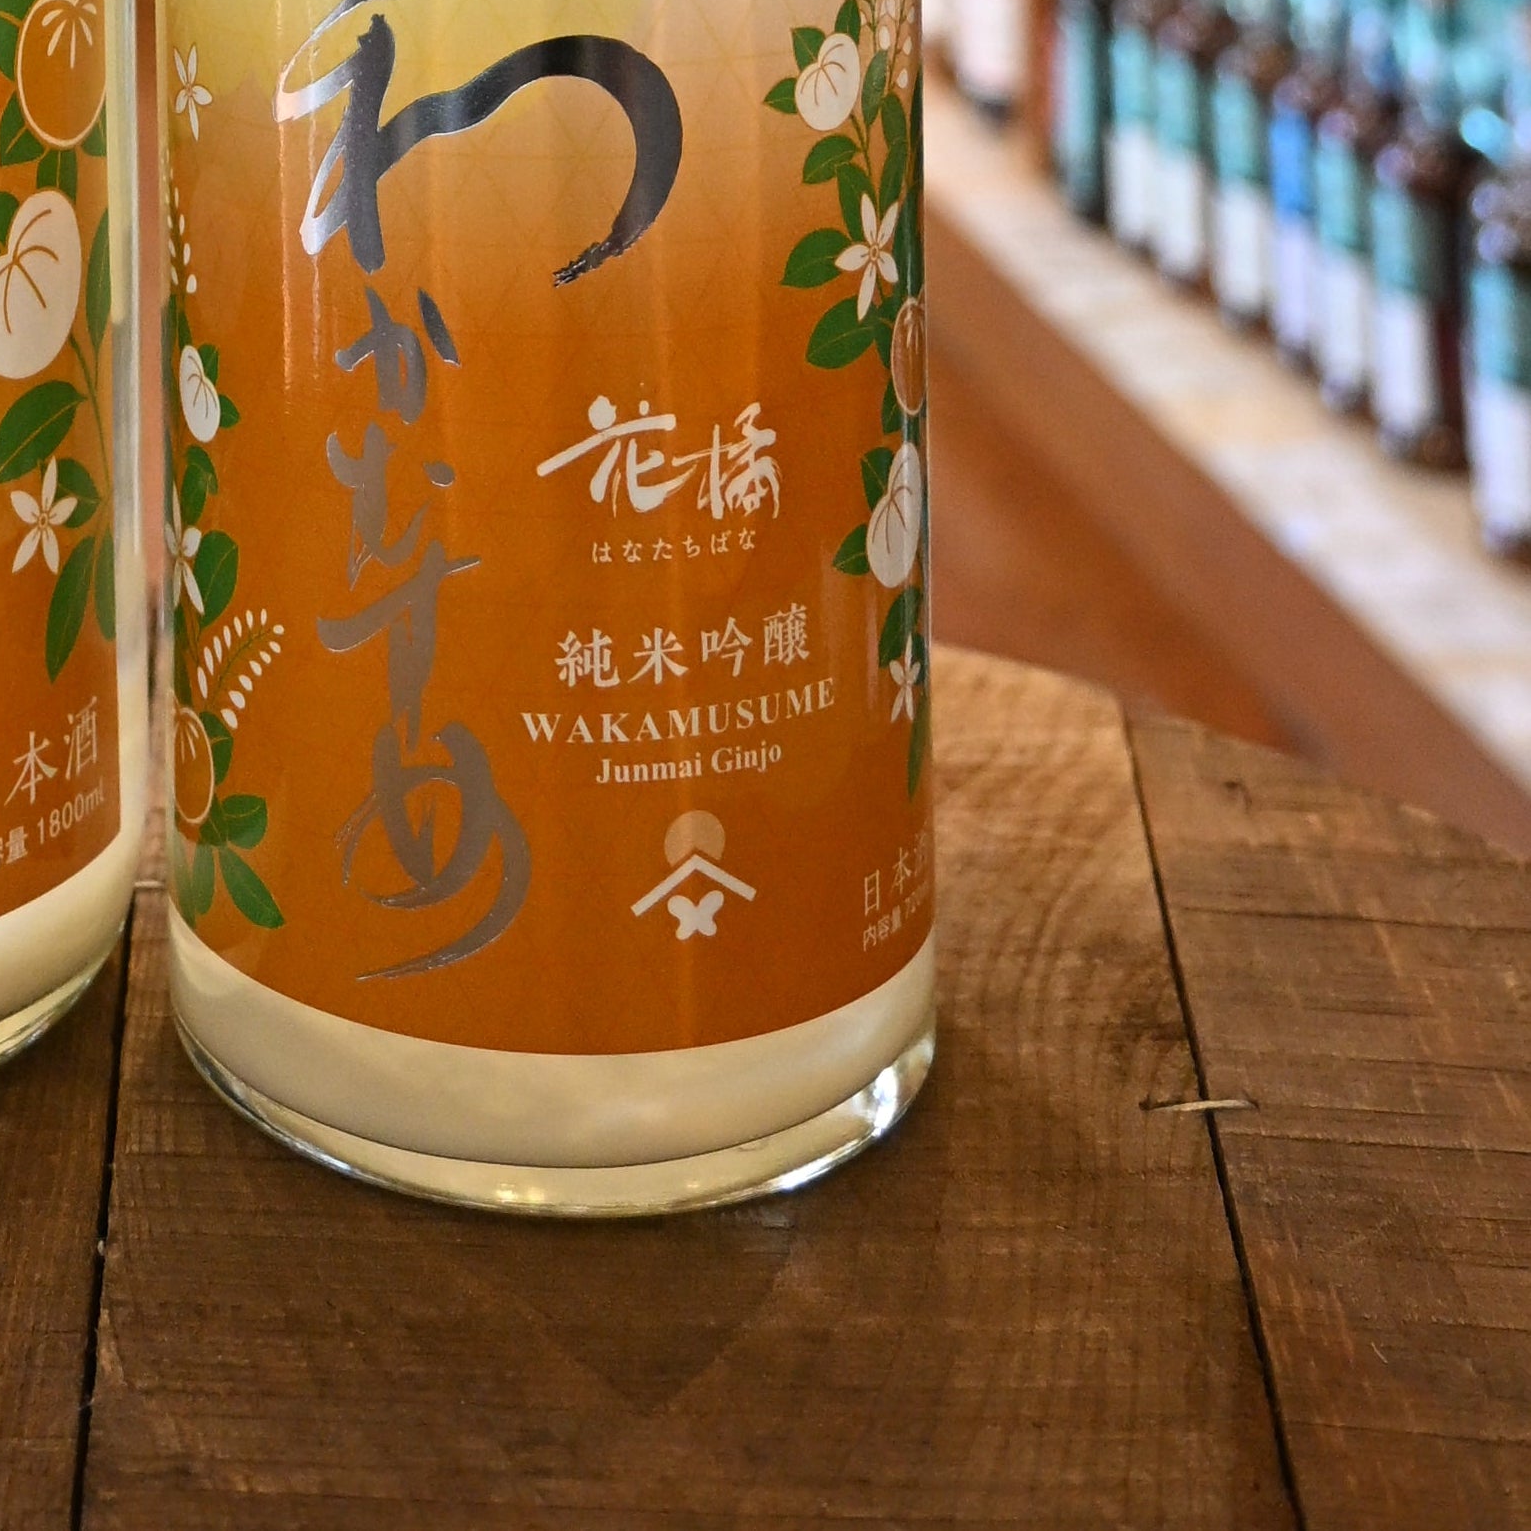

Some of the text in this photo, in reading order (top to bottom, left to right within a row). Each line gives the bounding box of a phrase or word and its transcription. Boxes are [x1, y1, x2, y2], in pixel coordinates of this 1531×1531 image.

[591, 527, 758, 565] はなたちばな
[555, 601, 812, 691] 純米吟醸
[519, 676, 837, 746] WAKAMUSUME
[594, 741, 783, 786] Junmai Ginjo
